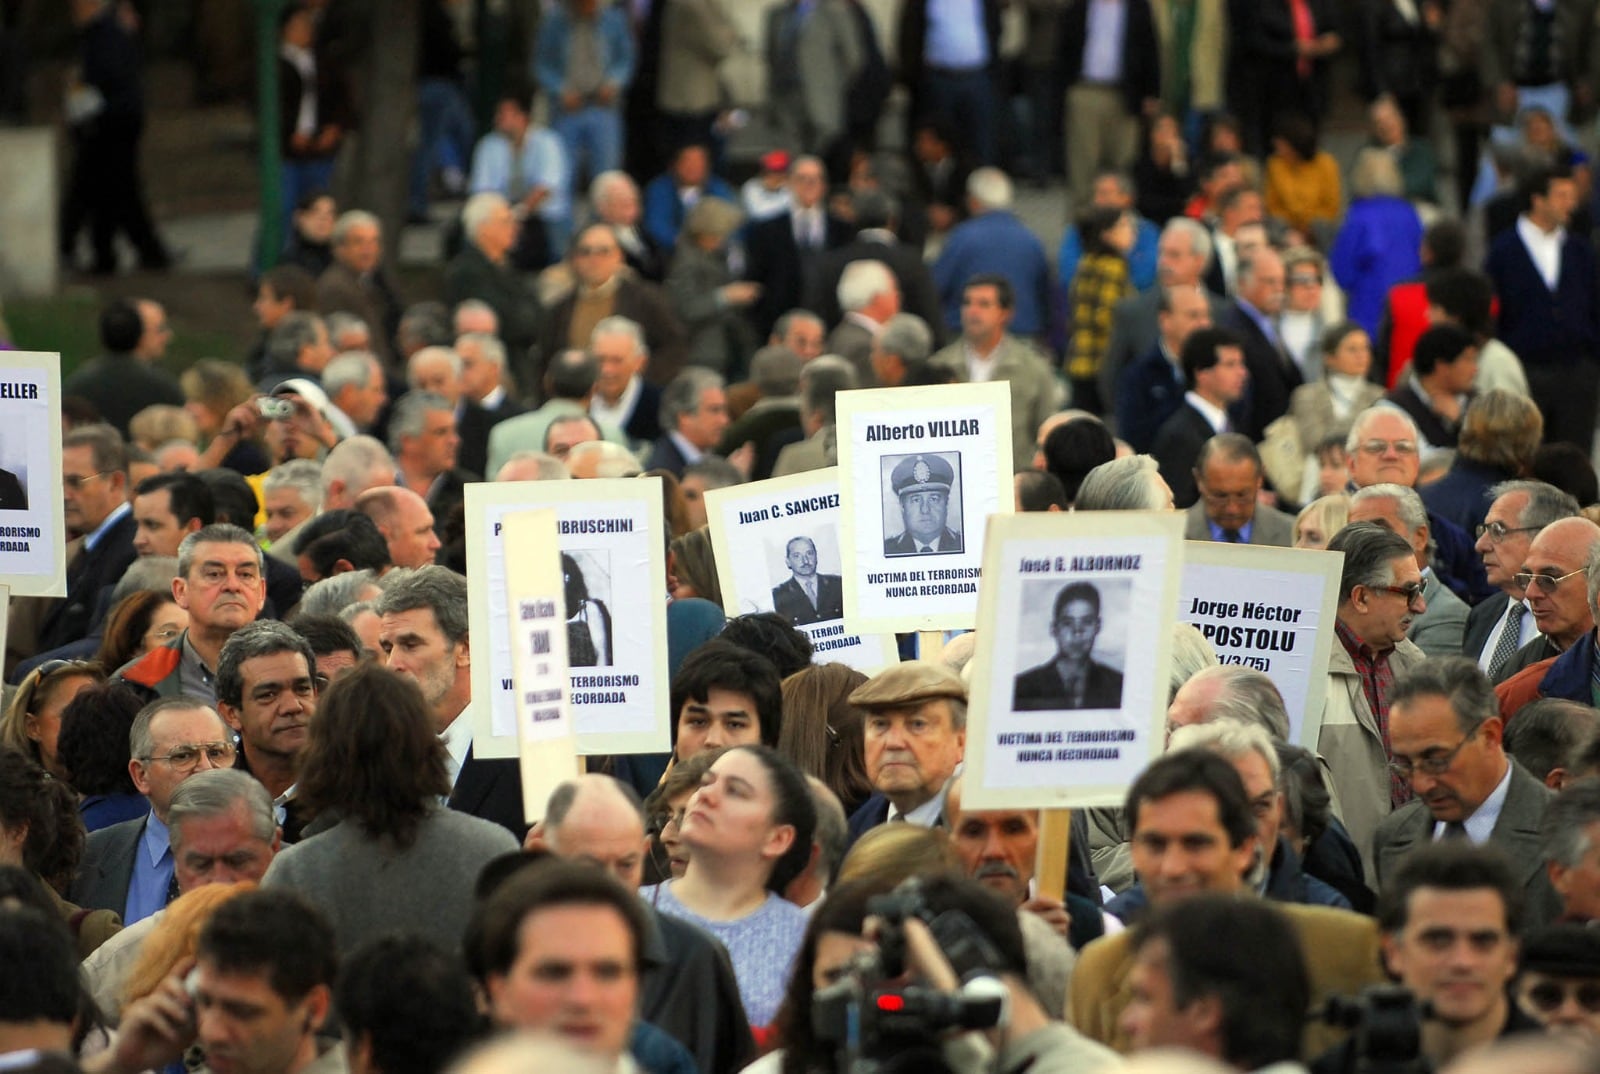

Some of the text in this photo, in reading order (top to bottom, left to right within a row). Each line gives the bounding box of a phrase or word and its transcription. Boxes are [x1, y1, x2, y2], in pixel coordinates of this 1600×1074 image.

[0, 383, 38, 399] ELLER
[866, 419, 980, 441] Alberto VILLAR
[739, 493, 840, 524] Juan C. SANCHEZ
[0, 526, 41, 538] RORISMO
[557, 519, 633, 534] BRUSCHINI
[0, 541, 30, 553] RDADA
[1070, 554, 1141, 571] ALBORNOZ
[868, 567, 982, 584] VICTIMA DEL TERRORISM
[886, 582, 977, 598] NUNCA RECORDADA
[1190, 598, 1302, 623] Jorge Héctor
[811, 624, 845, 640] TERROR
[1192, 623, 1296, 652] POSTOLU
[813, 635, 862, 652] ECORDADA
[1215, 654, 1271, 672] 1/3/75)
[570, 675, 640, 689] TERRORISMO
[570, 692, 626, 705] ECORDADA
[998, 729, 1136, 745] VICTIMA DEL TERRORISMO
[1016, 747, 1120, 762] NUNCA RECORDADA
